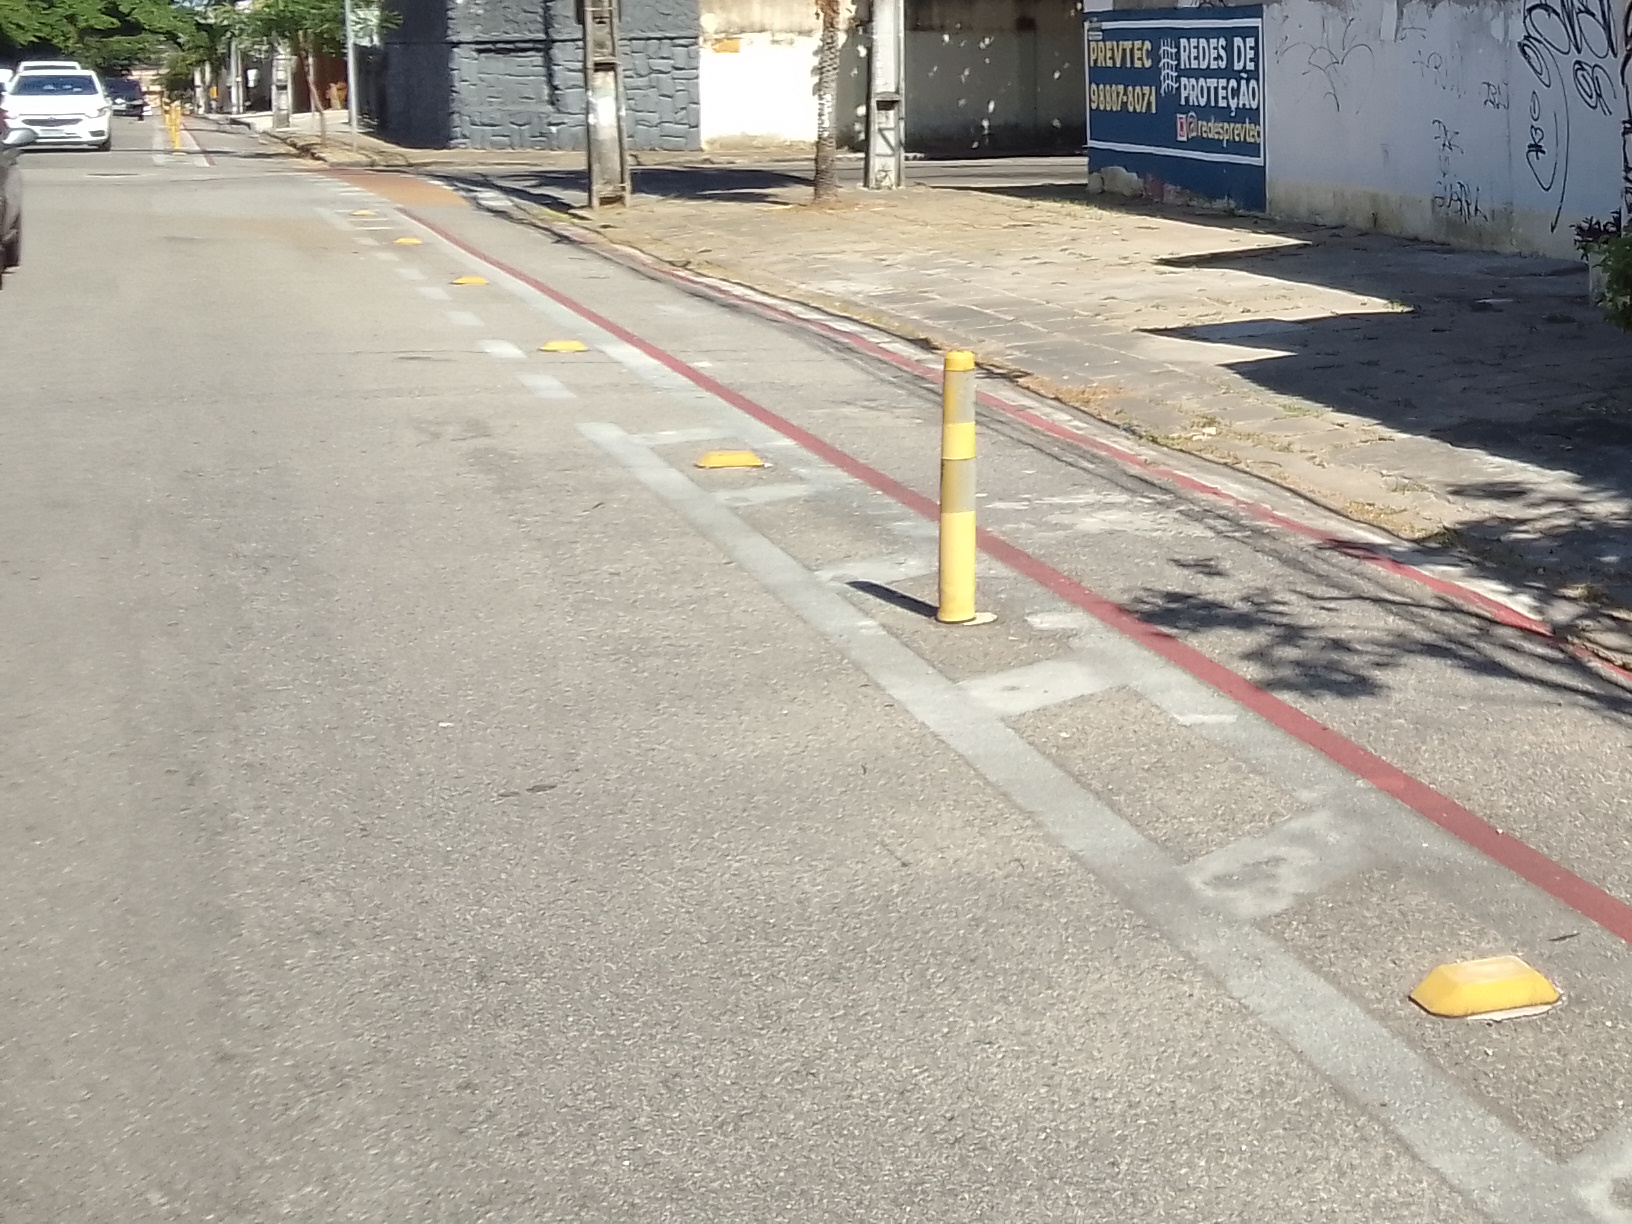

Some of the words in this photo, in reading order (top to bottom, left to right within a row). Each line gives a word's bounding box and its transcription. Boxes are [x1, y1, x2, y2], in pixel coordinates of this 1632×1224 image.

[1089, 40, 1152, 68] PREVTEC
[1179, 36, 1227, 70] REDES
[1233, 36, 1256, 71] DE
[1179, 72, 1259, 117] PROTEÇÃO
[1187, 111, 1261, 148] @redesprevtec
